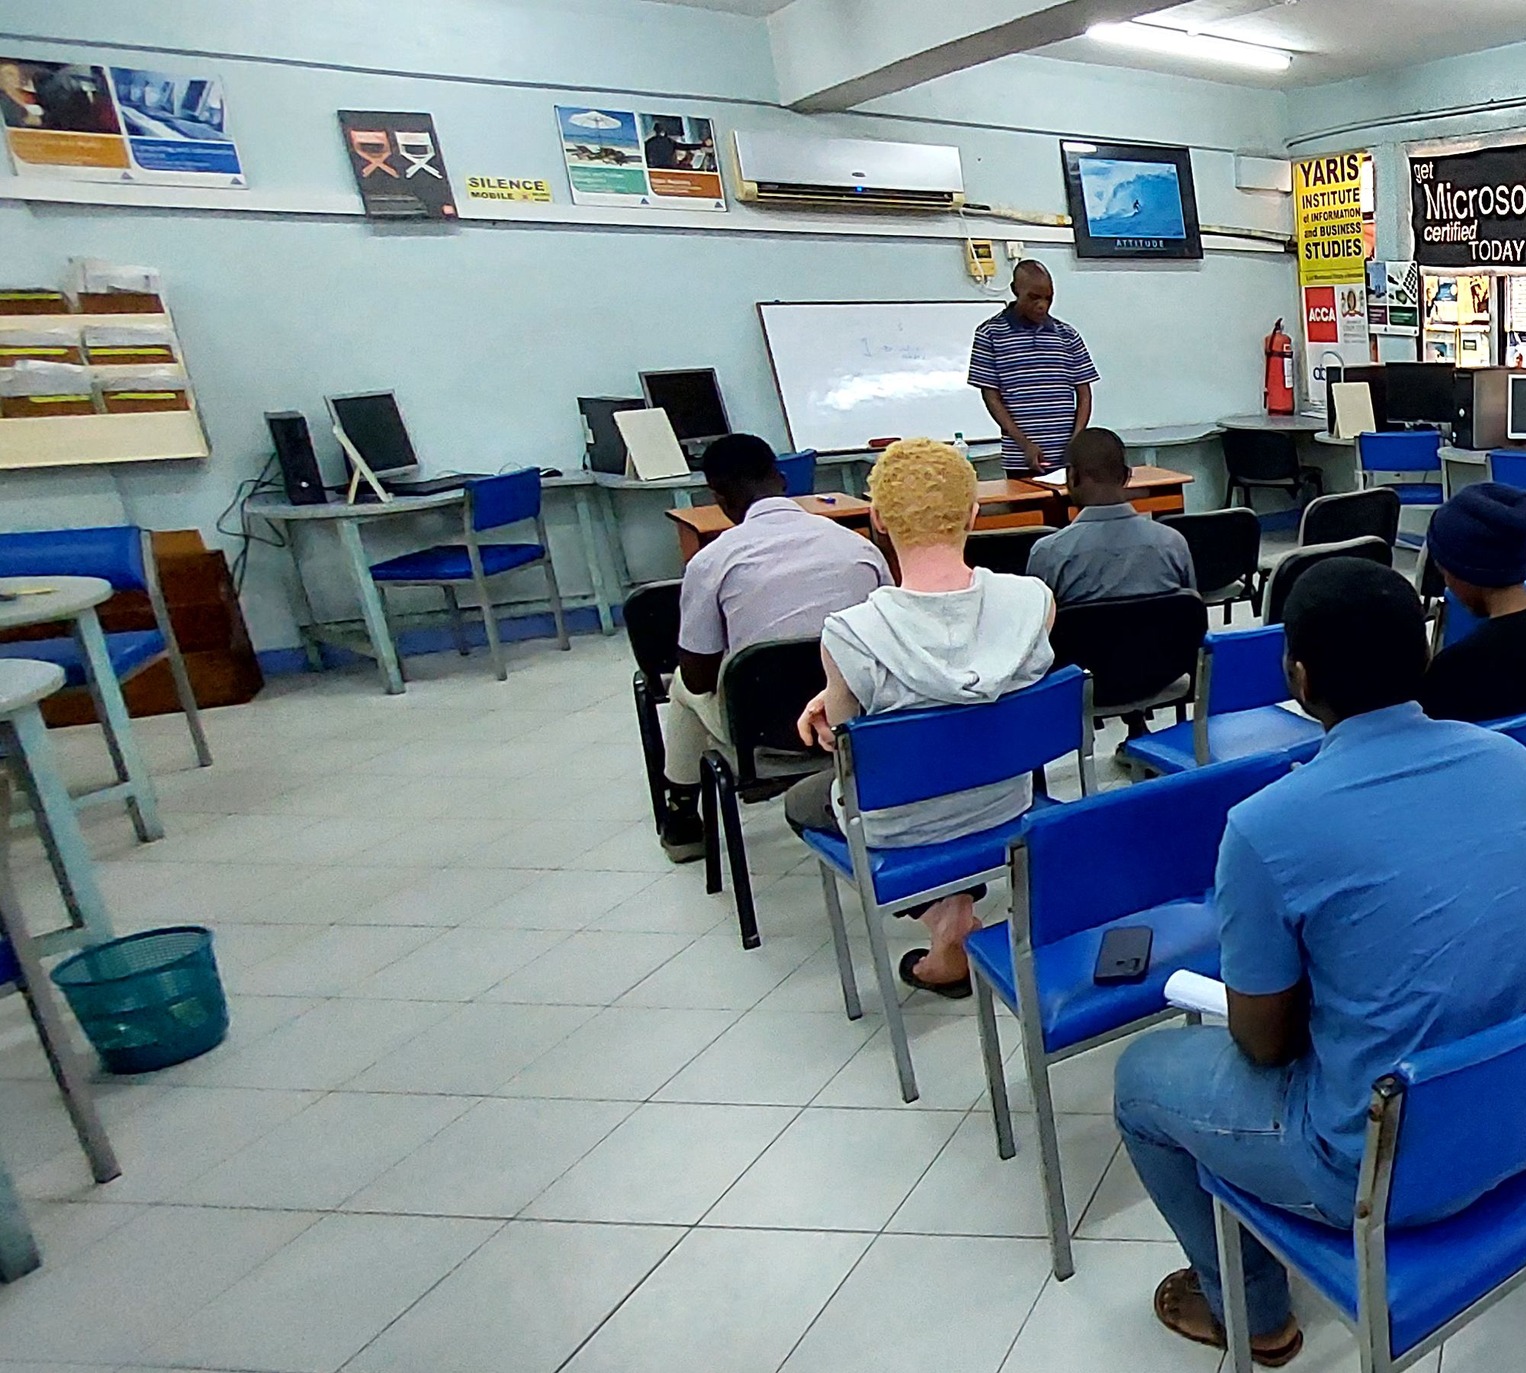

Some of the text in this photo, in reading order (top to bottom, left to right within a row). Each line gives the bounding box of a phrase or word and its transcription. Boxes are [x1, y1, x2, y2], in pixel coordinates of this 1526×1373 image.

[1300, 154, 1359, 188] YARIS
[1413, 161, 1434, 183] get
[468, 176, 545, 192] SILENCE
[470, 191, 515, 200] MOBILE
[1302, 187, 1360, 210] INSTITUTE
[1303, 207, 1361, 223] of INFORMATION
[1304, 221, 1361, 238] and BUSINESS
[1424, 219, 1478, 242] certified
[1116, 239, 1164, 248] ATTITUDE
[1305, 238, 1362, 260] STUDIES
[1468, 239, 1526, 262] TODAY
[1308, 307, 1336, 322] ACCA
